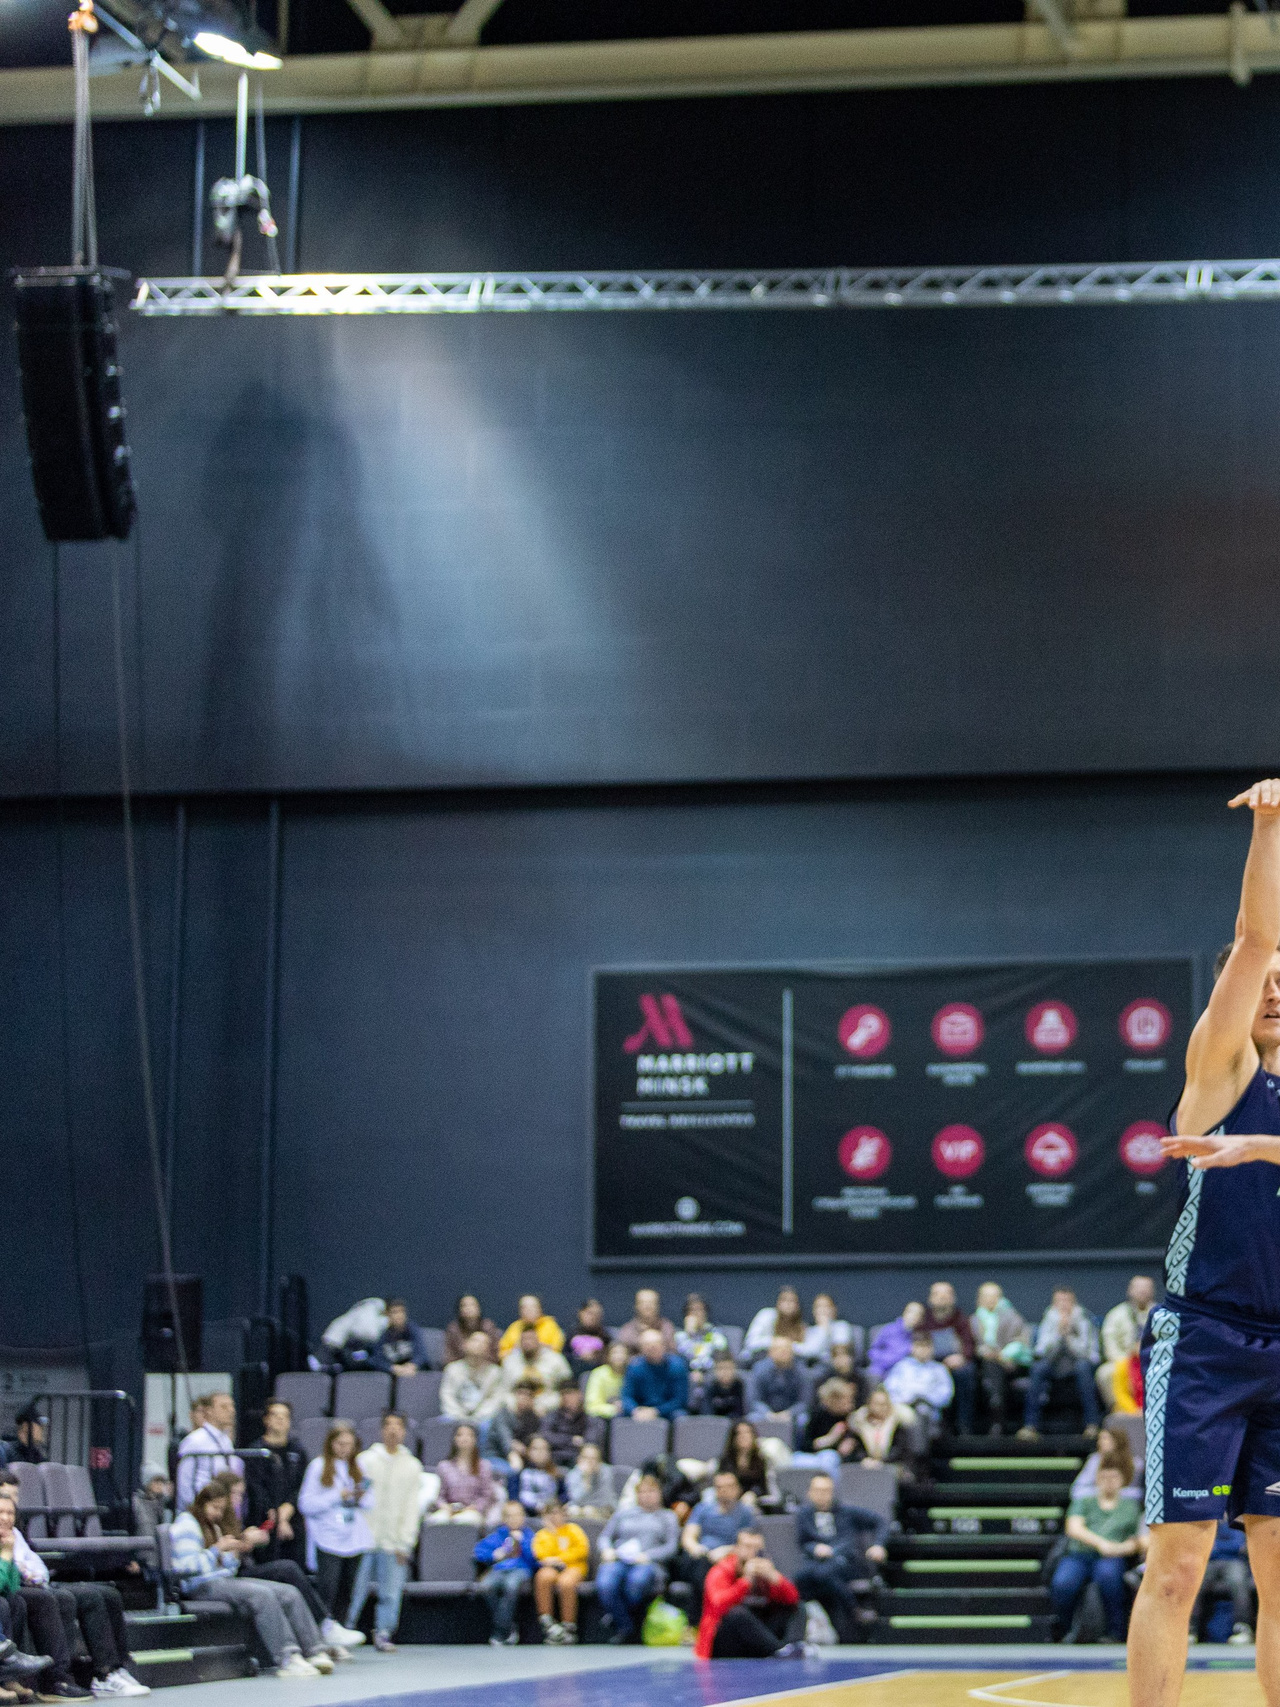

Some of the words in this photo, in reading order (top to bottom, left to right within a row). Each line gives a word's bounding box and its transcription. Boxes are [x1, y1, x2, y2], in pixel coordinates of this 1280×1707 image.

[637, 1053, 755, 1075] MARRIOTT
[637, 1076, 709, 1097] MINSK
[1172, 1487, 1209, 1500] Kempa
